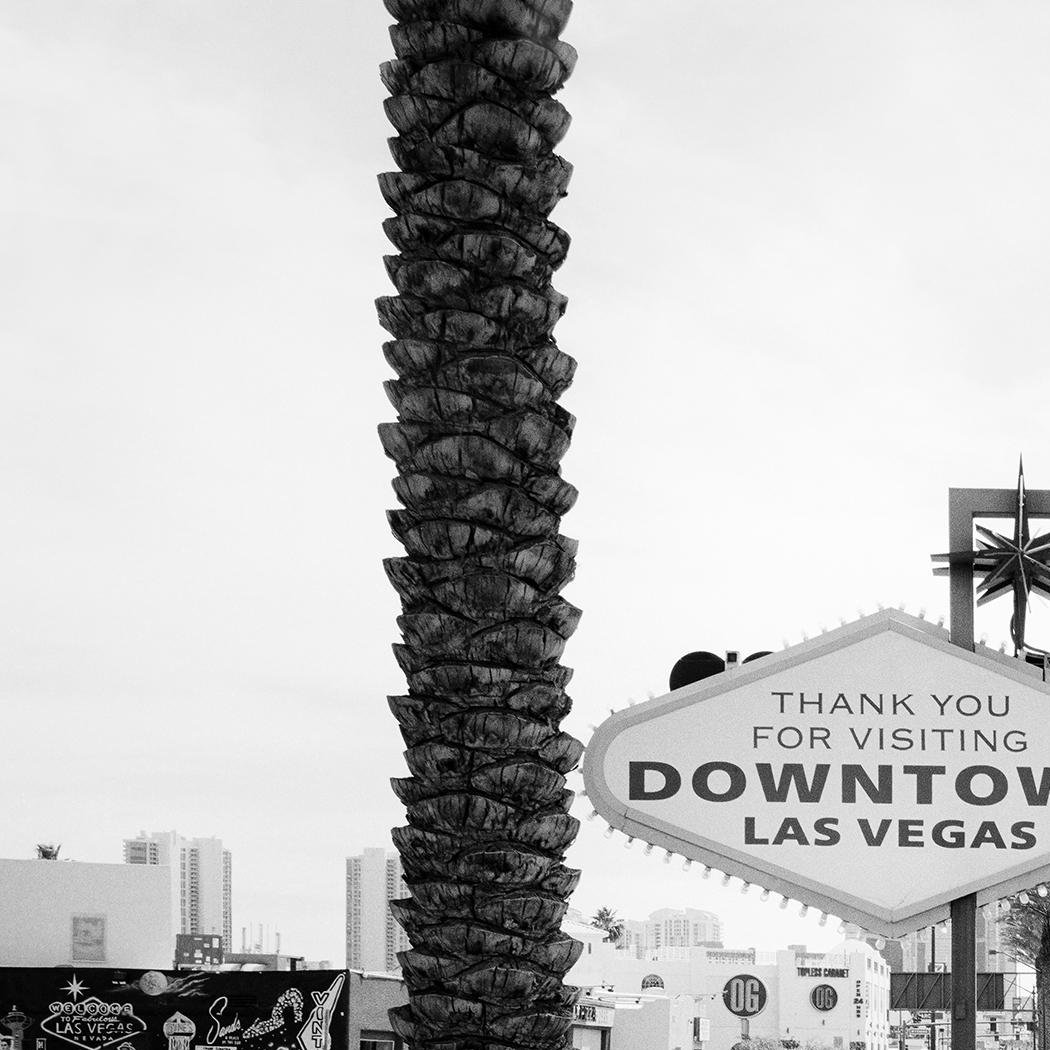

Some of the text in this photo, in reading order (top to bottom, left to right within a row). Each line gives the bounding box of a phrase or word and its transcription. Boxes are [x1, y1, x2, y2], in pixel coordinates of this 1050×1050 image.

[771, 691, 1011, 718] THANK YOU
[752, 726, 1029, 753] FOR VISITING
[744, 816, 1037, 850] LAS VEGAS
[50, 1003, 131, 1014] WELCOME
[730, 978, 760, 1013] OG
[815, 986, 834, 1010] OG
[56, 1022, 134, 1034] LAS VEGAS
[207, 996, 241, 1045] Sands
